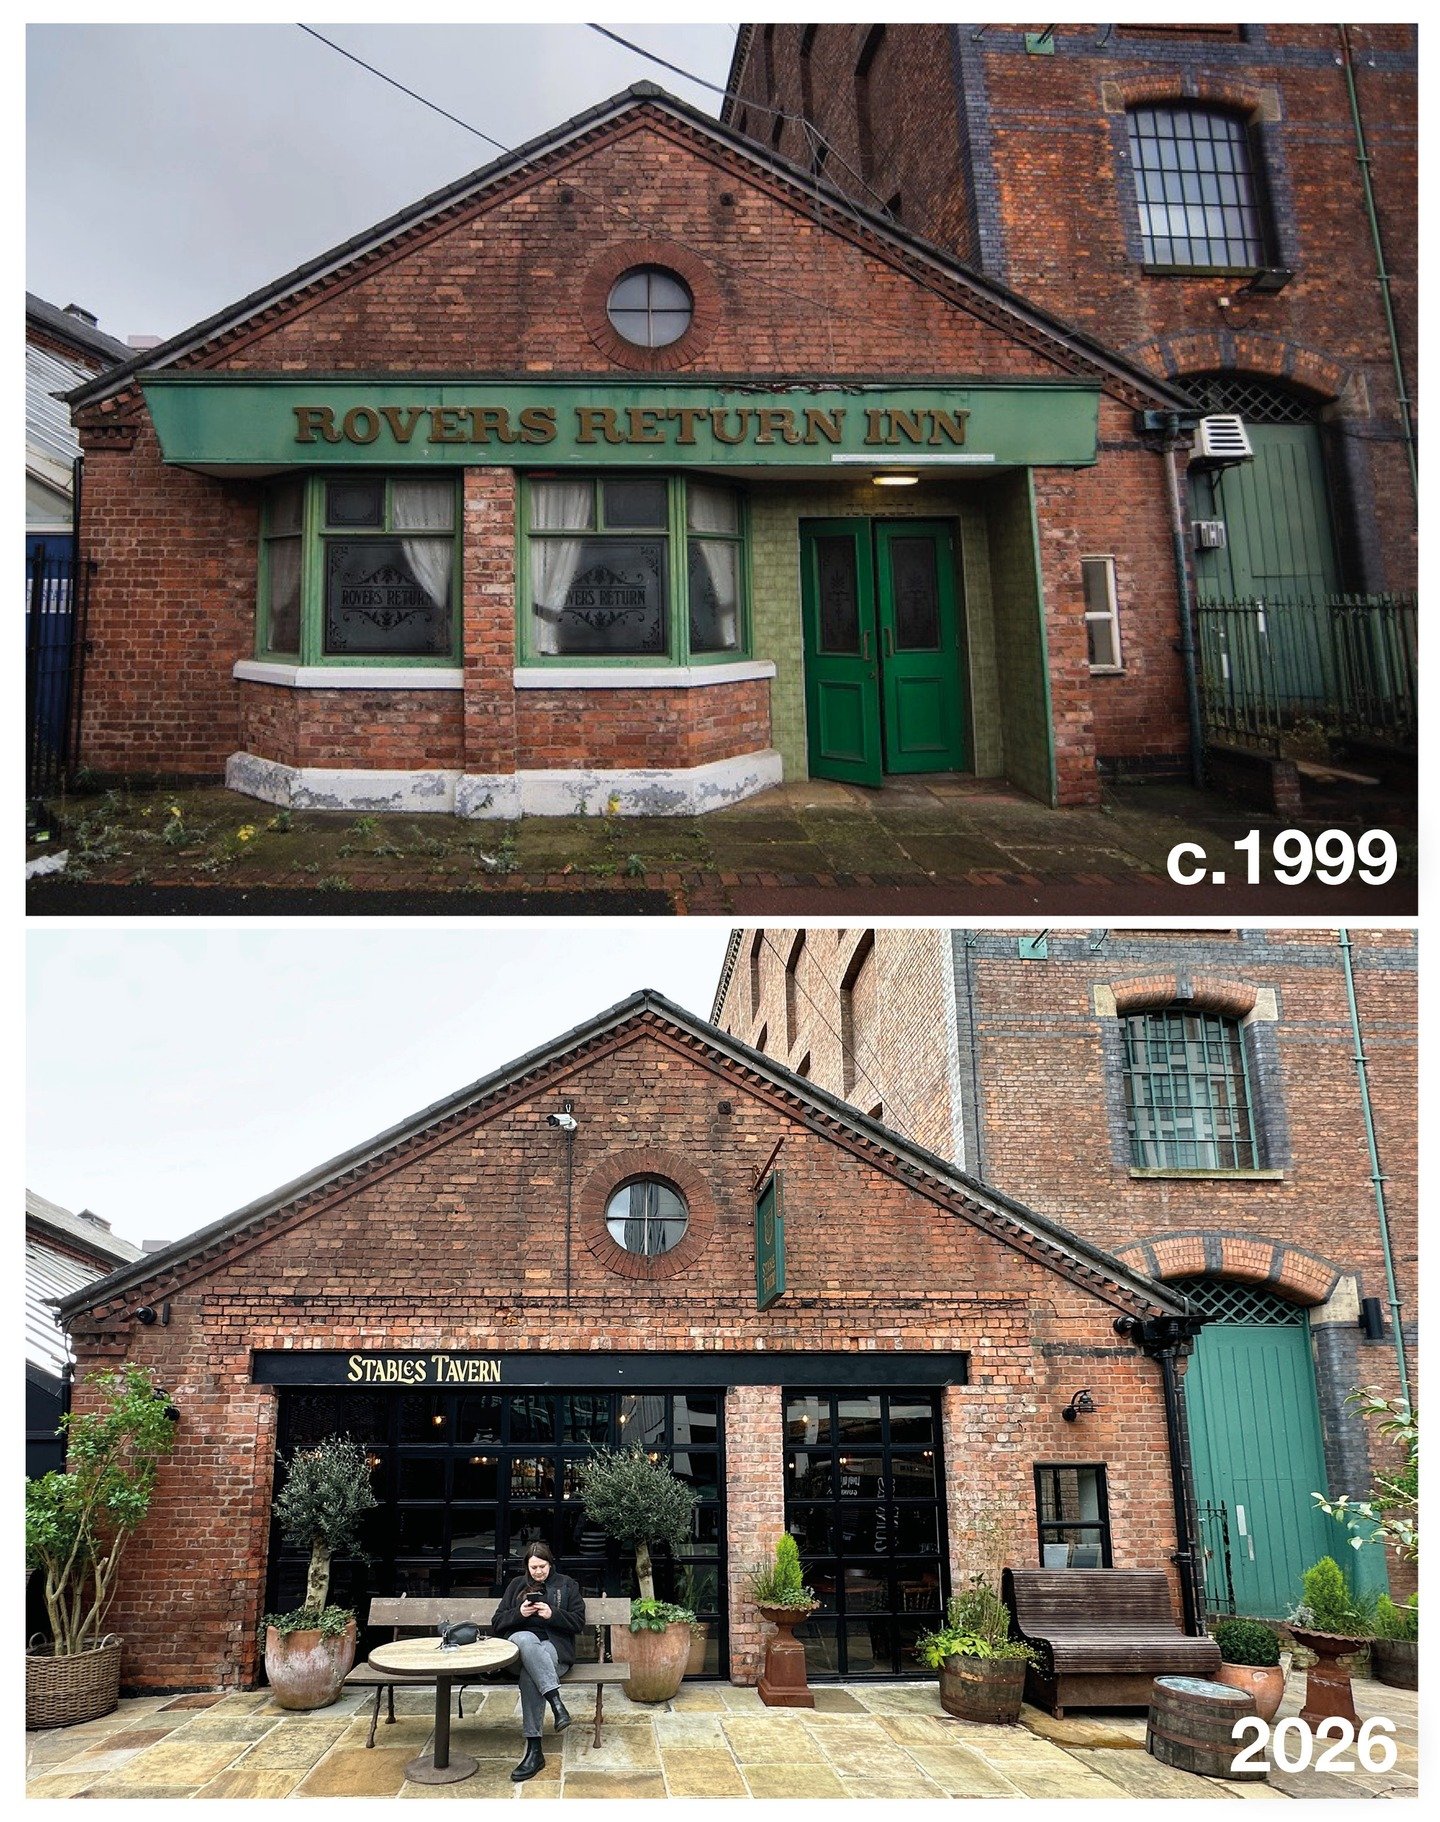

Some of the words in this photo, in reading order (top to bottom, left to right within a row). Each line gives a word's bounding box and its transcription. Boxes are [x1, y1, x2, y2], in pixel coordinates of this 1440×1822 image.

[293, 405, 558, 444] ROVERS
[574, 406, 847, 445] RETURN
[863, 407, 971, 445] INN
[565, 590, 595, 606] VERS
[599, 590, 645, 606] RETURN
[347, 1355, 427, 1384] STABLES
[431, 1355, 502, 1383] TAVERN
